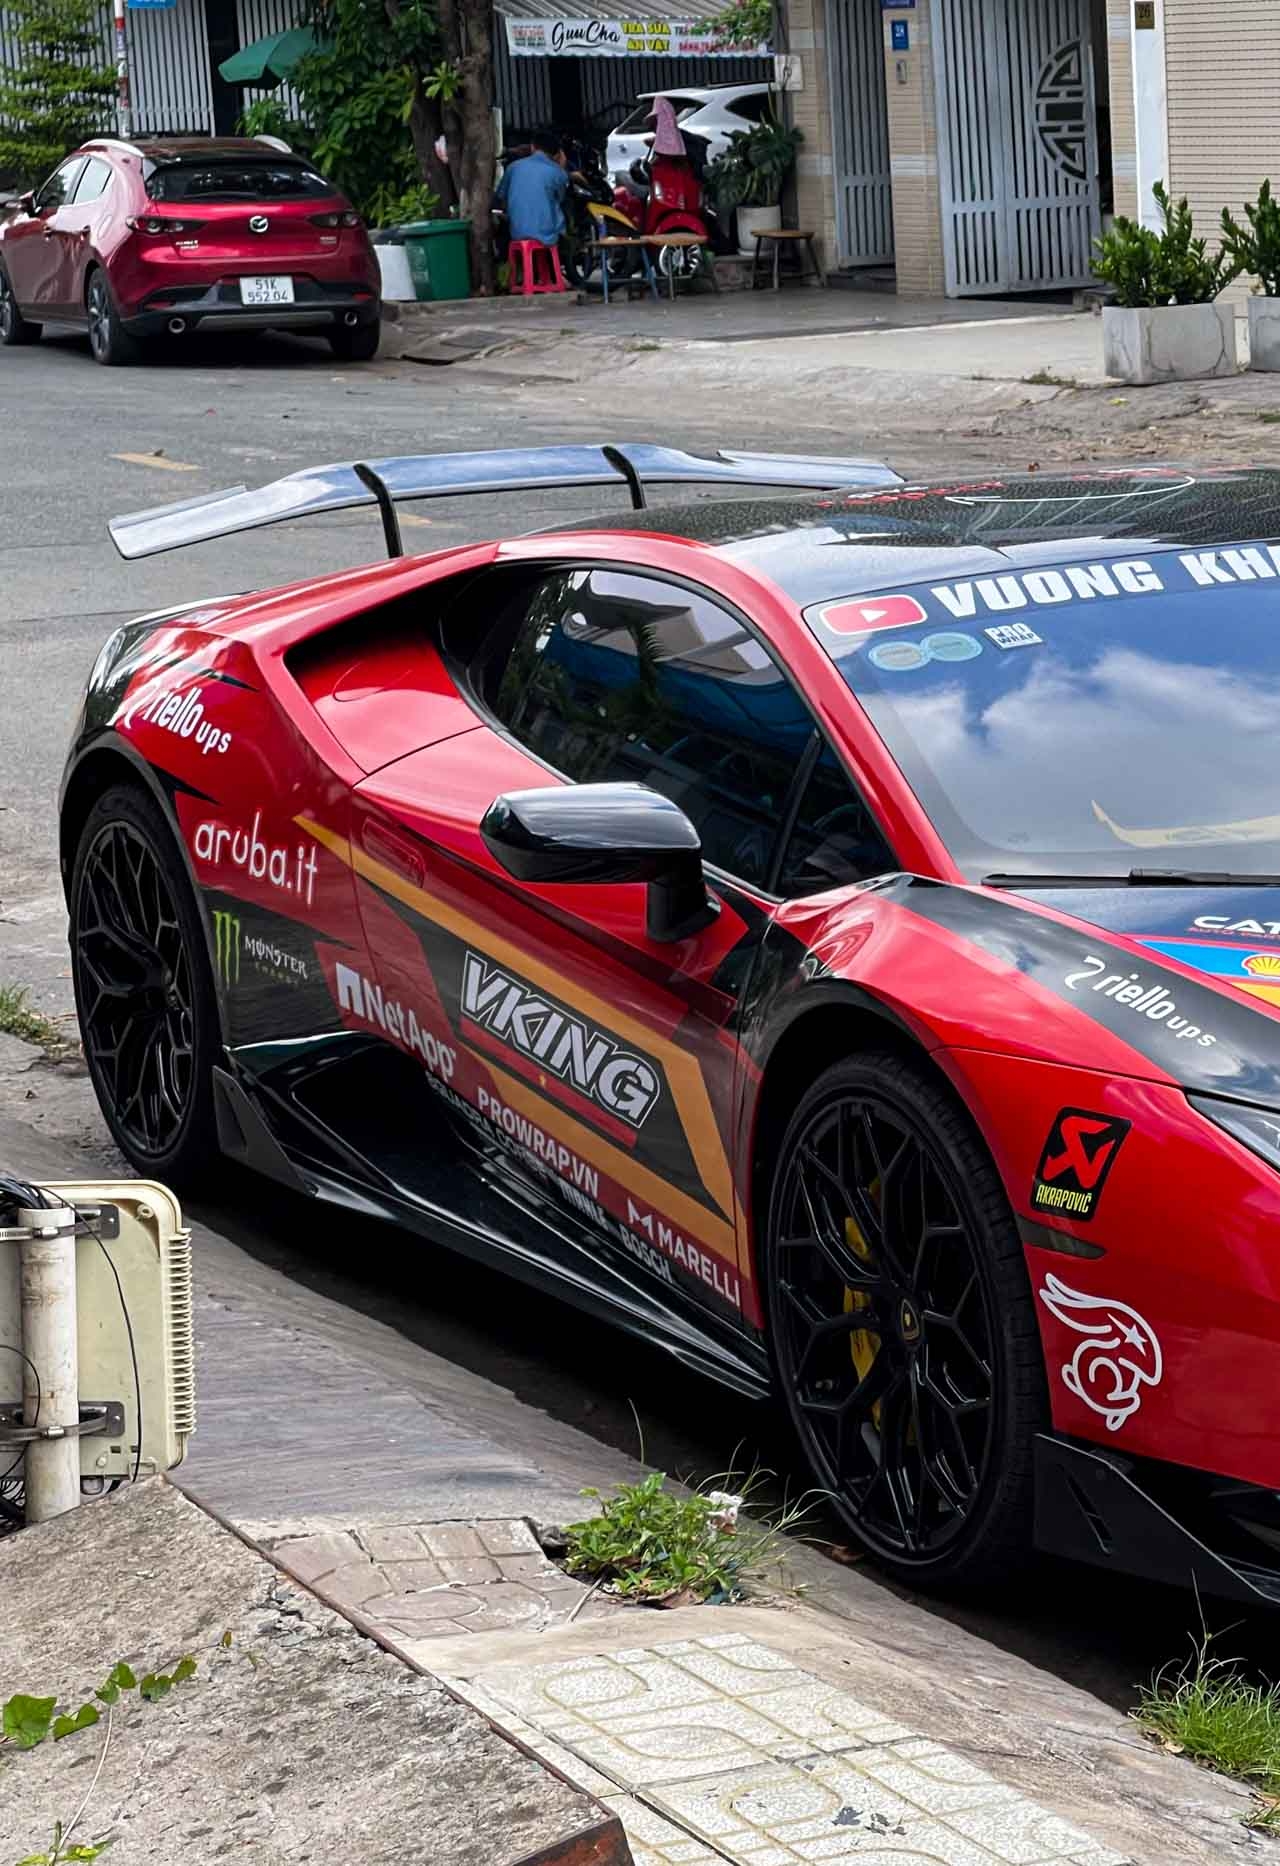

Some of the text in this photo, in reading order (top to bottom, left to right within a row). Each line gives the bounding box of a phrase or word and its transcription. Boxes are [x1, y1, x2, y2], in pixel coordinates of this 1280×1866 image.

[247, 290, 288, 302] 552.04
[255, 279, 277, 290] 51K
[931, 561, 1164, 617] VUONG
[991, 623, 1030, 636] PRO
[998, 632, 1035, 645] WRAP
[143, 683, 232, 754] riello ups
[195, 810, 317, 905] aruba.it
[244, 935, 308, 980] MONSTER
[362, 977, 456, 1083] NetApp
[1092, 973, 1216, 1046] riello ups
[478, 1086, 598, 1199] PROWRAP.VN
[1036, 1183, 1092, 1214] AKRAPOVIČ
[619, 1223, 672, 1284] BOSCH
[658, 1221, 741, 1308] MARELLI
